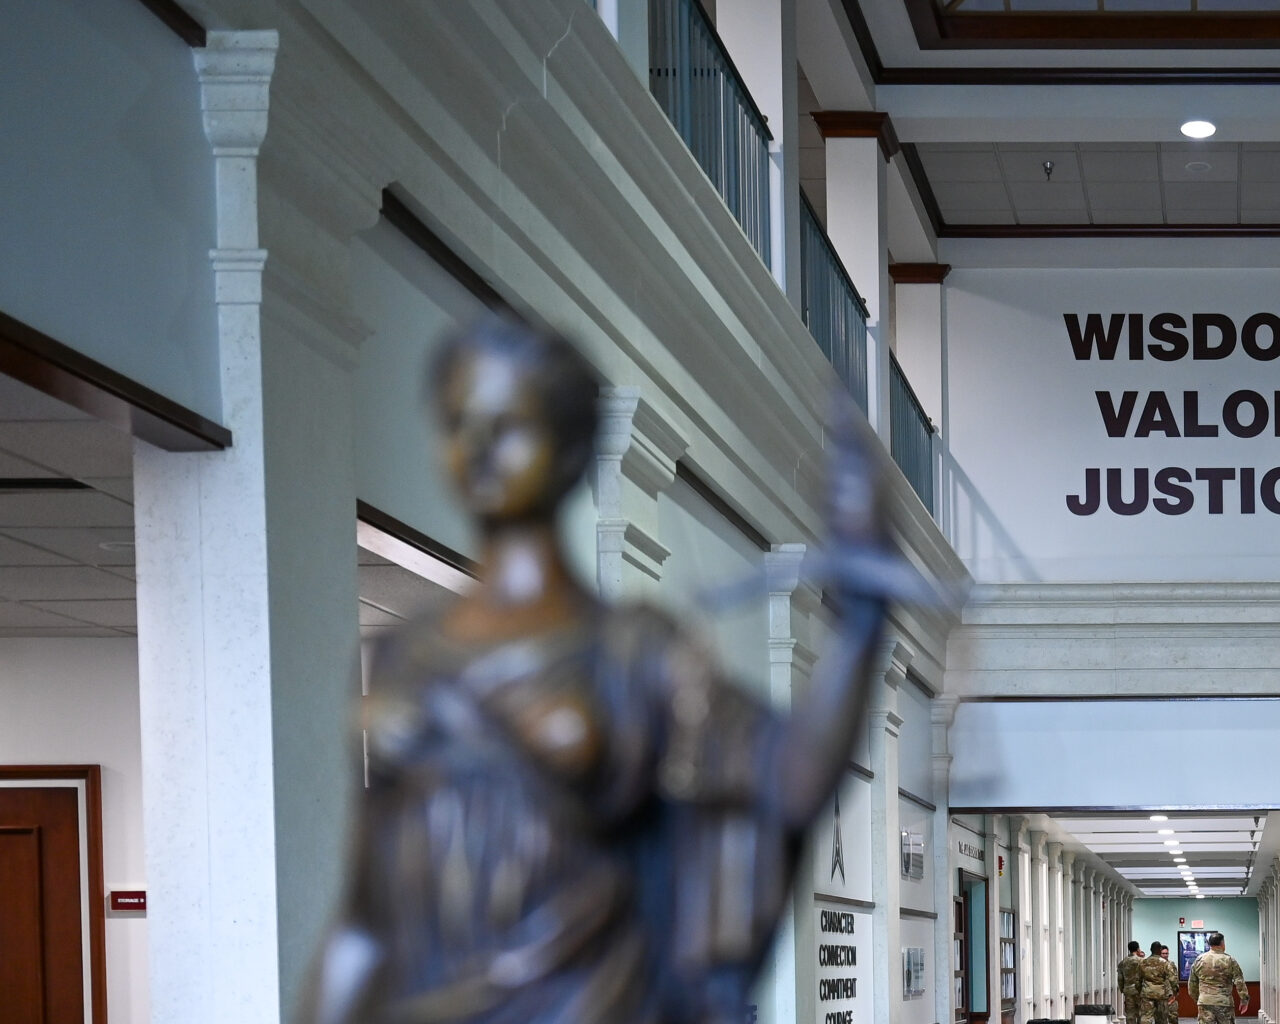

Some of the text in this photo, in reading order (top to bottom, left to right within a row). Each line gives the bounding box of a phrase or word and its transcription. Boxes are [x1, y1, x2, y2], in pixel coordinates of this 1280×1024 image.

[820, 909, 855, 934] CHARACTER
[819, 943, 857, 967] CONNECTION
[819, 977, 858, 1001] COMMITMENT
